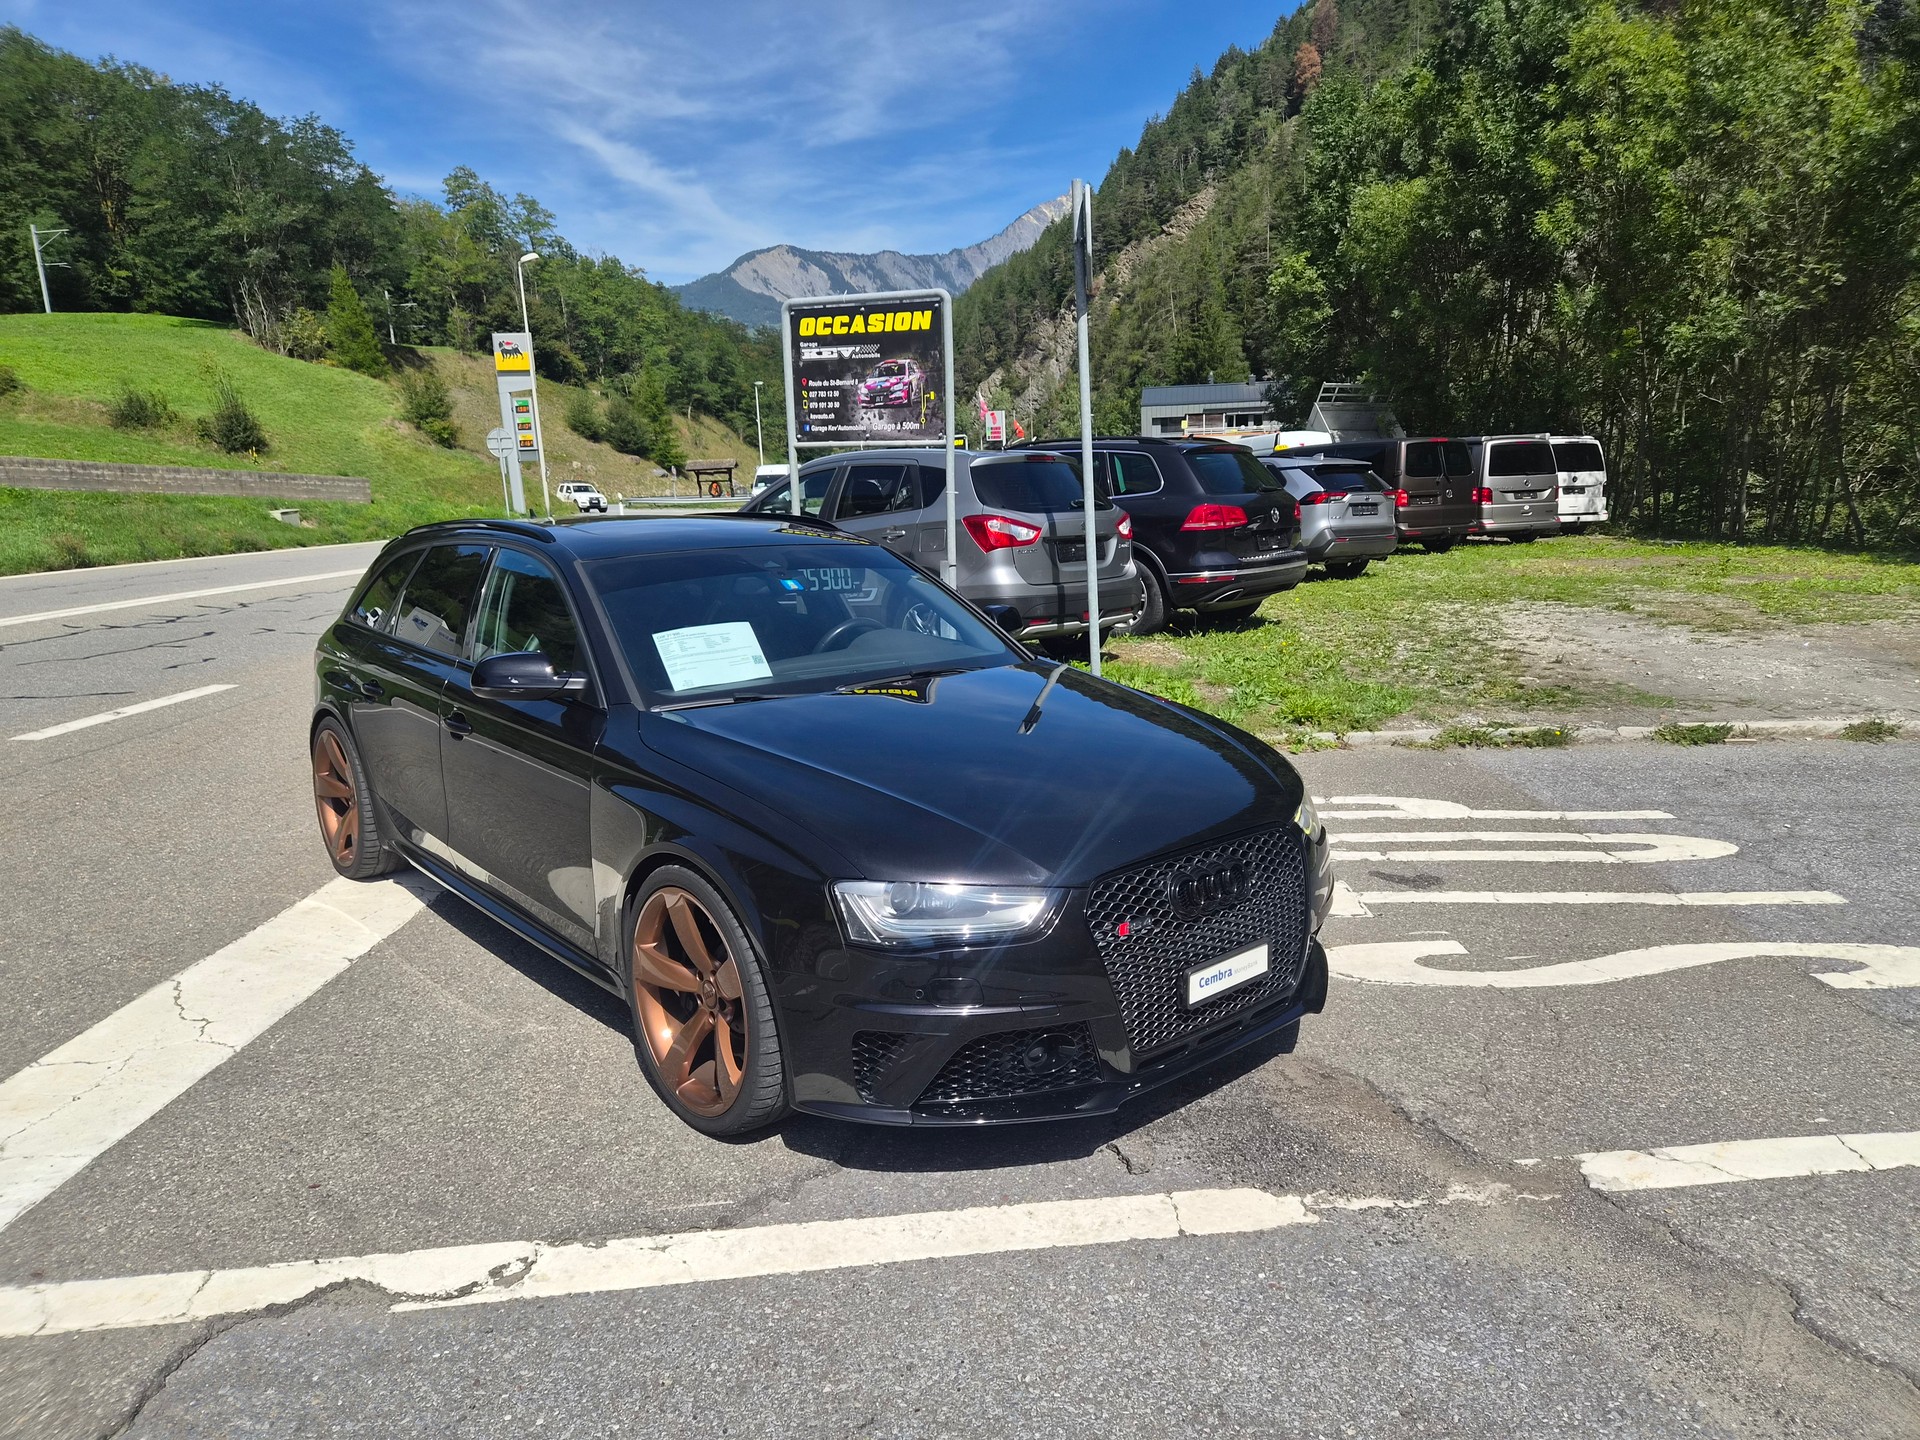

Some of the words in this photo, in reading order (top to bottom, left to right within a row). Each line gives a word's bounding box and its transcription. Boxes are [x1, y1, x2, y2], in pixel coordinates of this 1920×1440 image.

[799, 310, 932, 336] OCCASION
[872, 422, 896, 432] Garage
[896, 421, 901, 430] à
[902, 421, 920, 430] 500m
[1199, 968, 1233, 988] Cembra
